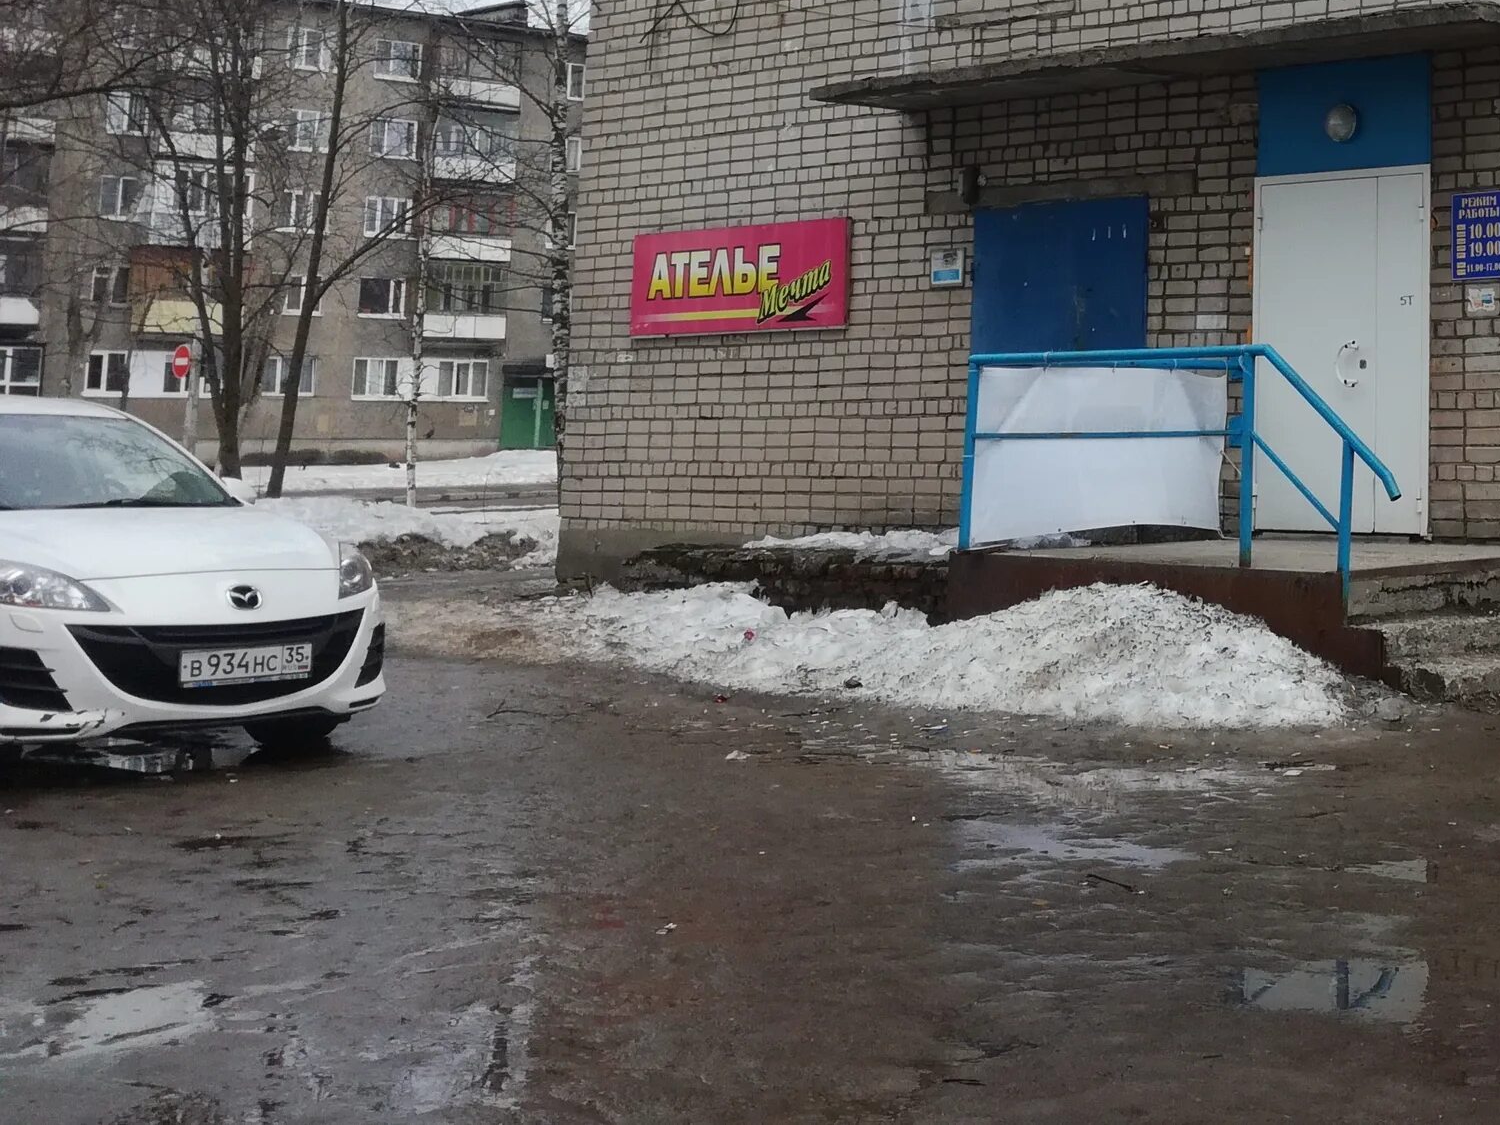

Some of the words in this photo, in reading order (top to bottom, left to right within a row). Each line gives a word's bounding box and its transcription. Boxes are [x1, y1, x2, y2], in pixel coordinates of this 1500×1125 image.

[1461, 196, 1497, 208] РЕЖИМ
[1459, 207, 1500, 220] РАБОТЫ
[647, 243, 781, 301] АТЕЛЬЕ
[756, 260, 832, 324] Мечта
[285, 646, 304, 663] 35
